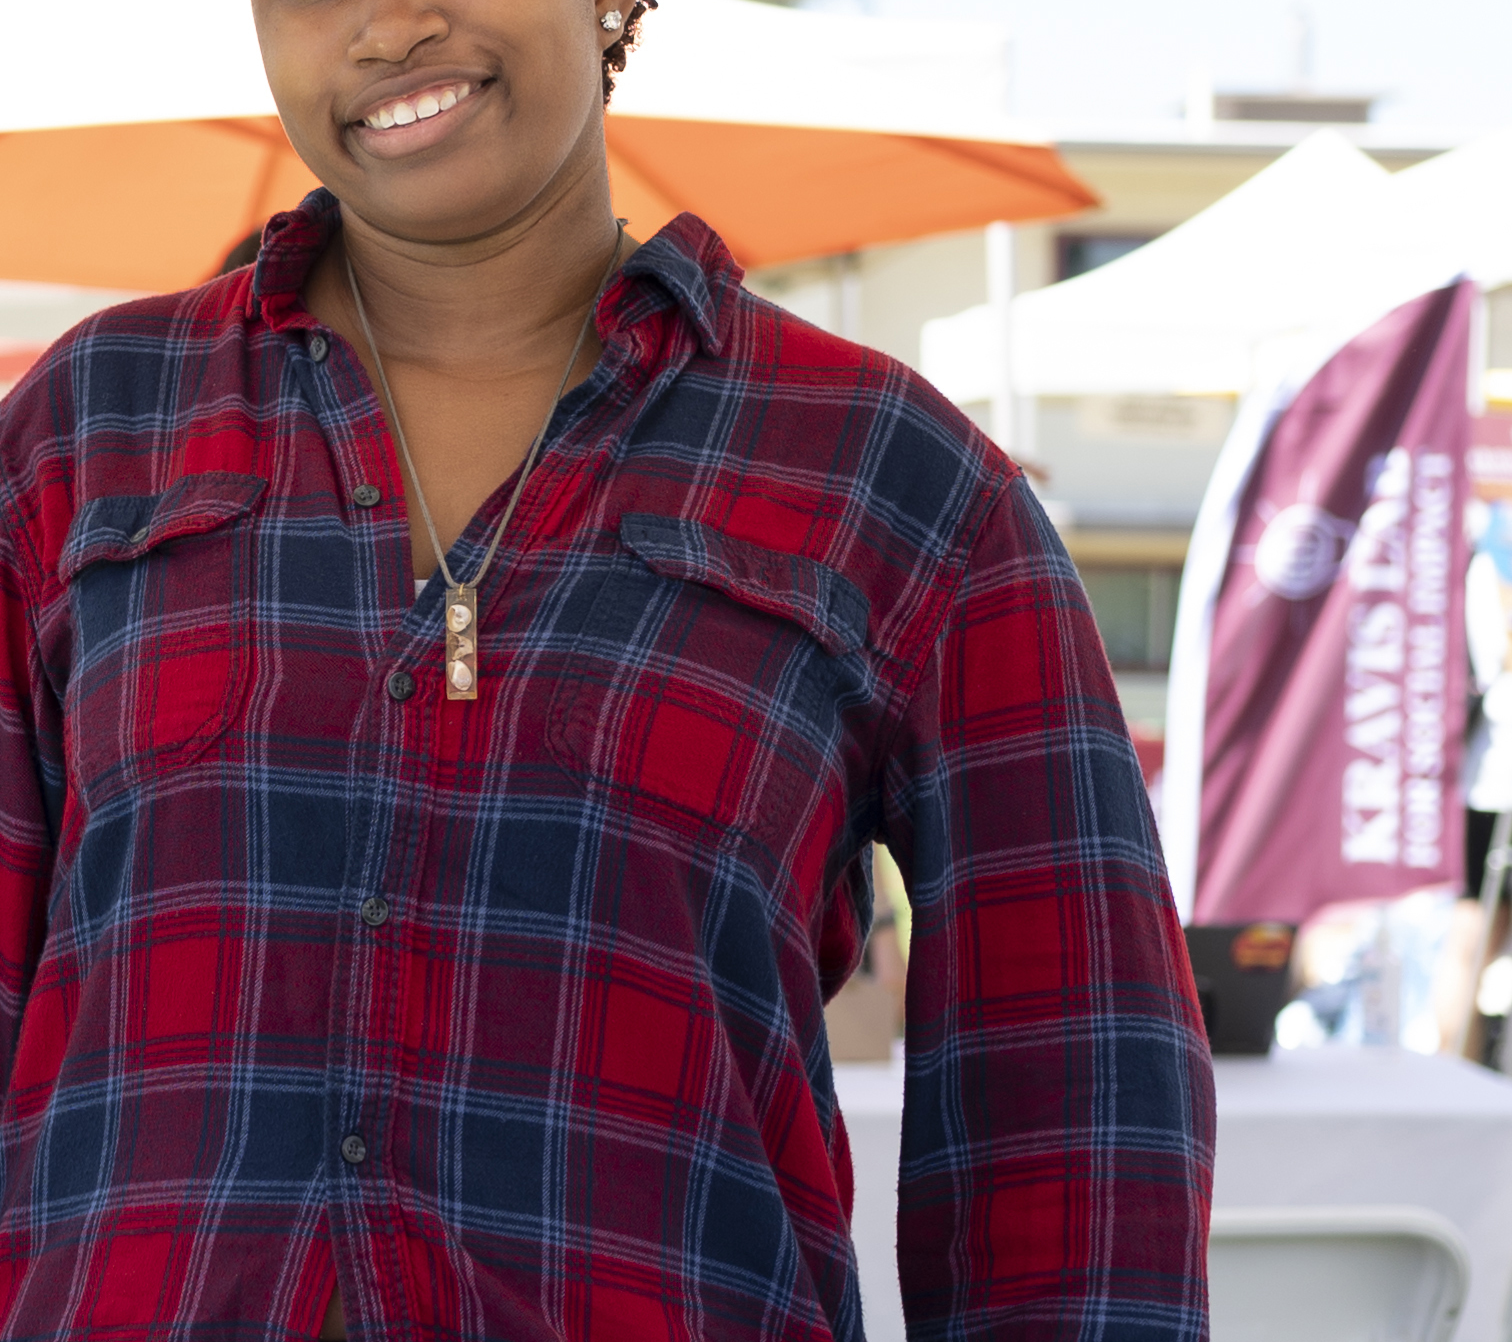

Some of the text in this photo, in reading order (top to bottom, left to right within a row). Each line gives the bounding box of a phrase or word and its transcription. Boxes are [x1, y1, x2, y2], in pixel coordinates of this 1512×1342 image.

[1341, 600, 1406, 865] KRAVIS
[1403, 451, 1454, 868] FOR SOCIAL IMPACT
